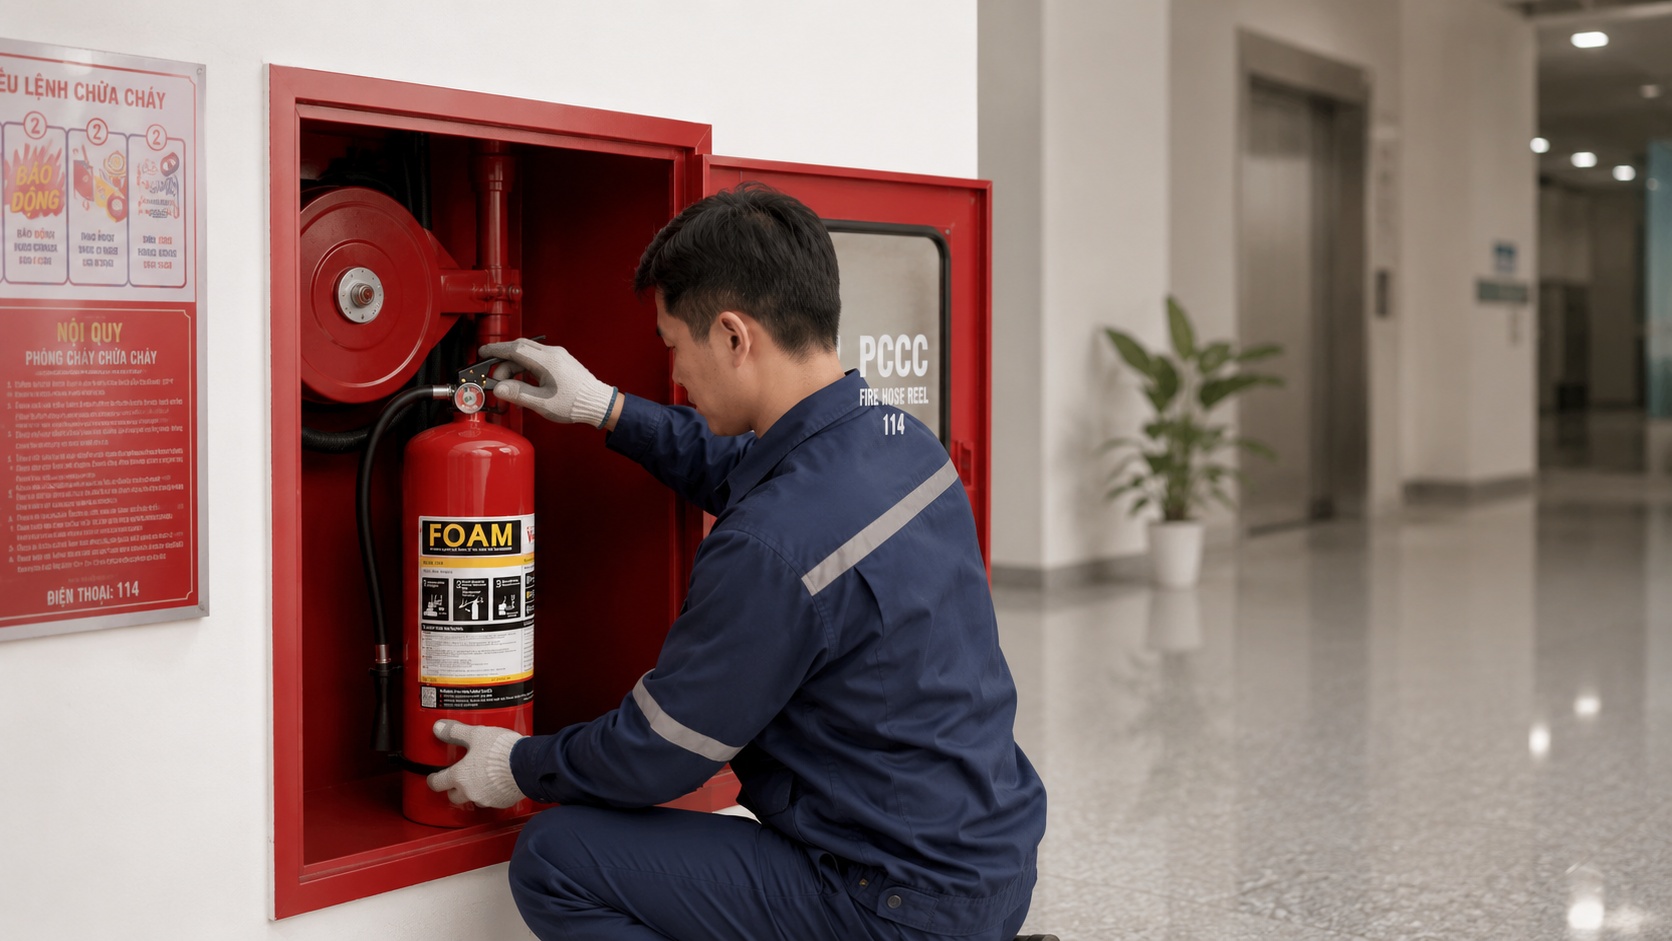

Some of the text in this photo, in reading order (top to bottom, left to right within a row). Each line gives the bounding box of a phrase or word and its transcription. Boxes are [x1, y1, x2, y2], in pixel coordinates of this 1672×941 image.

[25, 72, 68, 101] LỆNH
[124, 86, 166, 110] CHÁY
[31, 117, 40, 134] 2
[93, 123, 101, 140] 2
[152, 129, 160, 145] 2
[57, 317, 123, 347] NỘI QUY
[859, 333, 929, 378] PCCC
[859, 386, 929, 407] FIRE HOSE REEL
[882, 412, 905, 436] 114
[429, 523, 513, 548] FOAM
[77, 584, 114, 606] THOẠI:
[117, 580, 139, 599] 114
